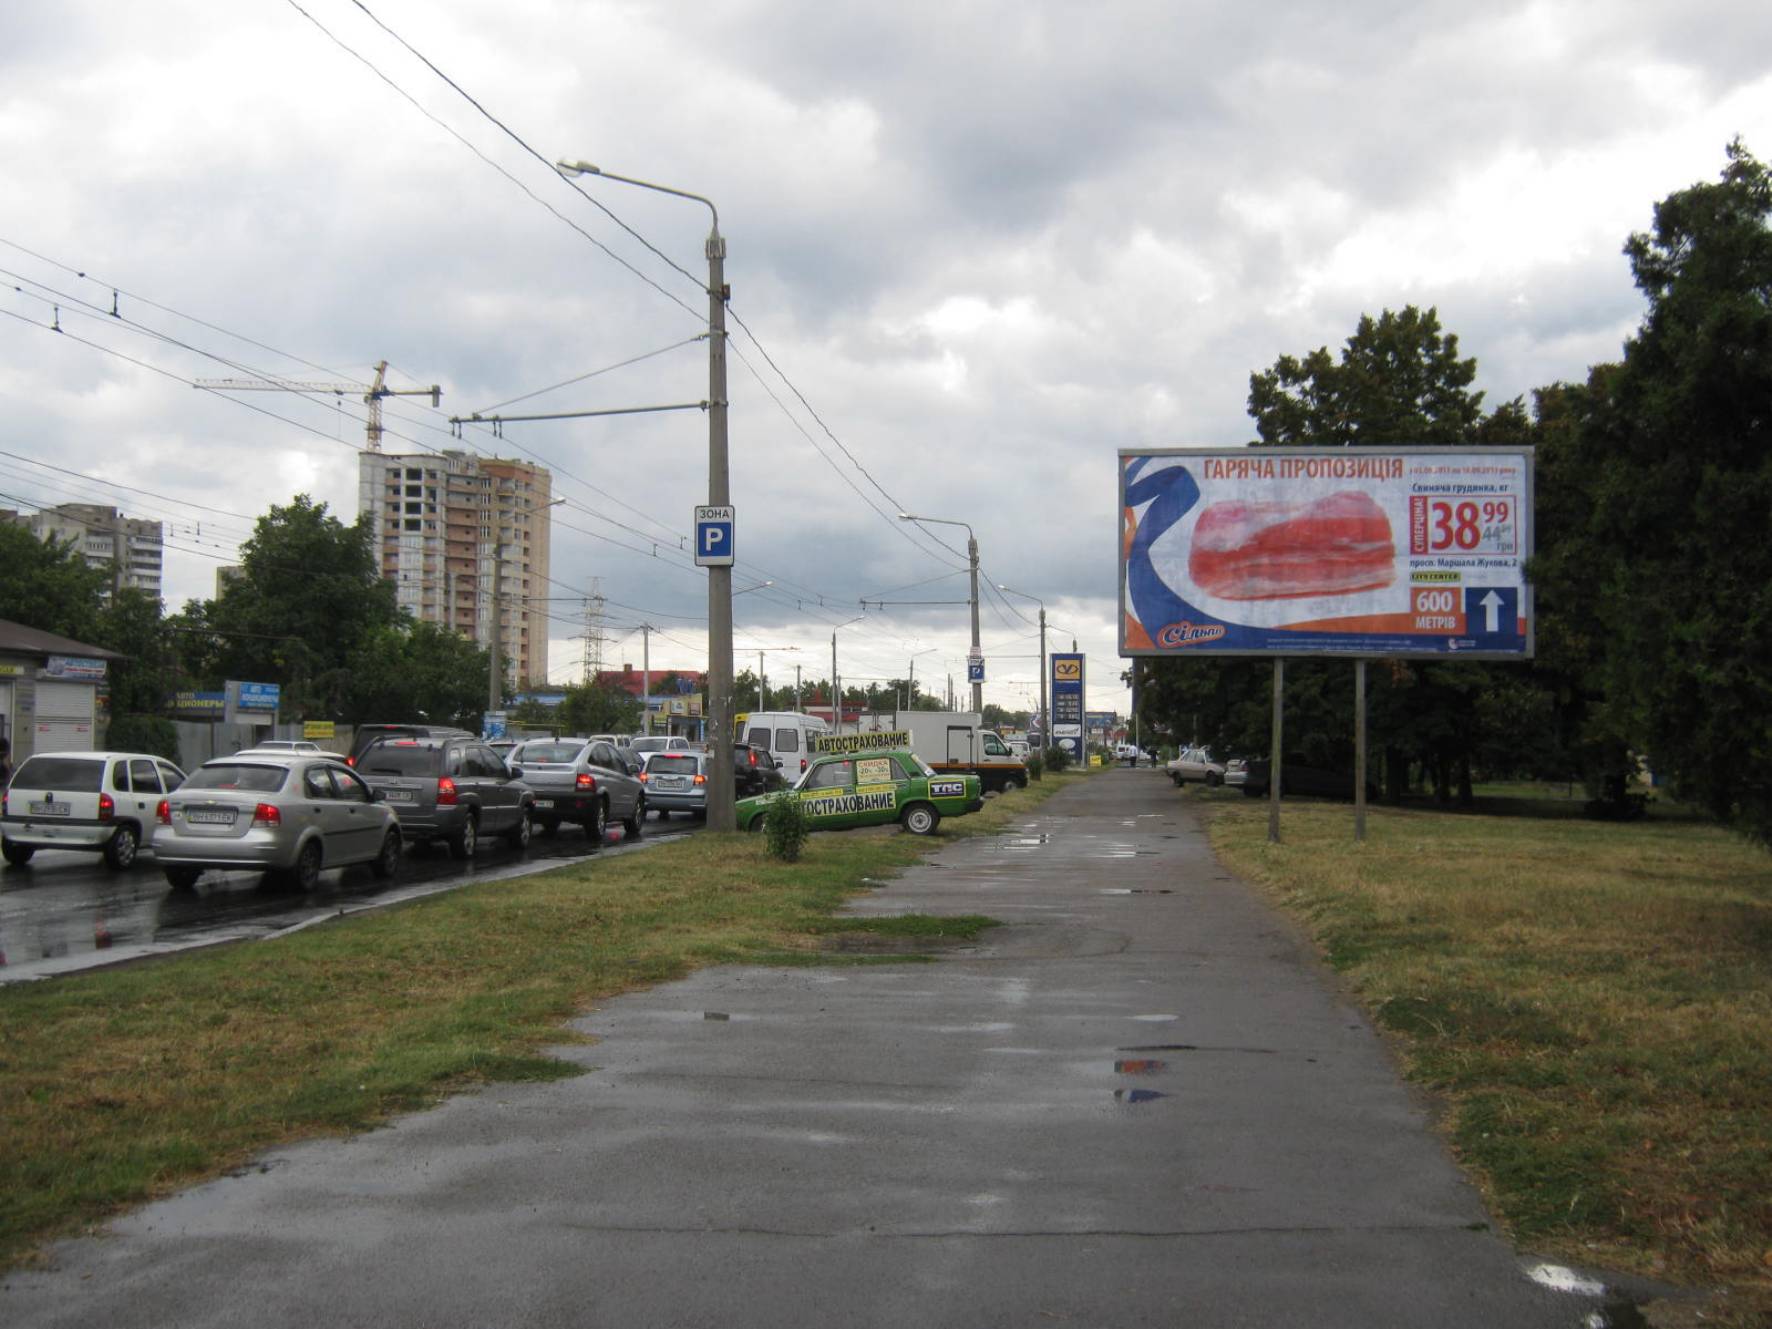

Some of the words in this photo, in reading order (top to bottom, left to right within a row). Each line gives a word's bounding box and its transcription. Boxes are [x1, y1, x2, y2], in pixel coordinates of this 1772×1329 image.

[1203, 459, 1274, 479] ГАРЯЧА
[1280, 458, 1403, 482] ПРОПОЗИЦІЯ
[1412, 482, 1451, 493] Свиняча
[700, 509, 730, 519] ЗОНА
[1431, 501, 1481, 550] 38
[1483, 502, 1508, 523] 99
[706, 528, 724, 551] P
[1437, 558, 1475, 569] Маршала
[1416, 591, 1454, 612] 600
[1415, 616, 1456, 629] МЕТРІВ
[819, 732, 908, 752] АВТОСТРАХОВАНИЕ
